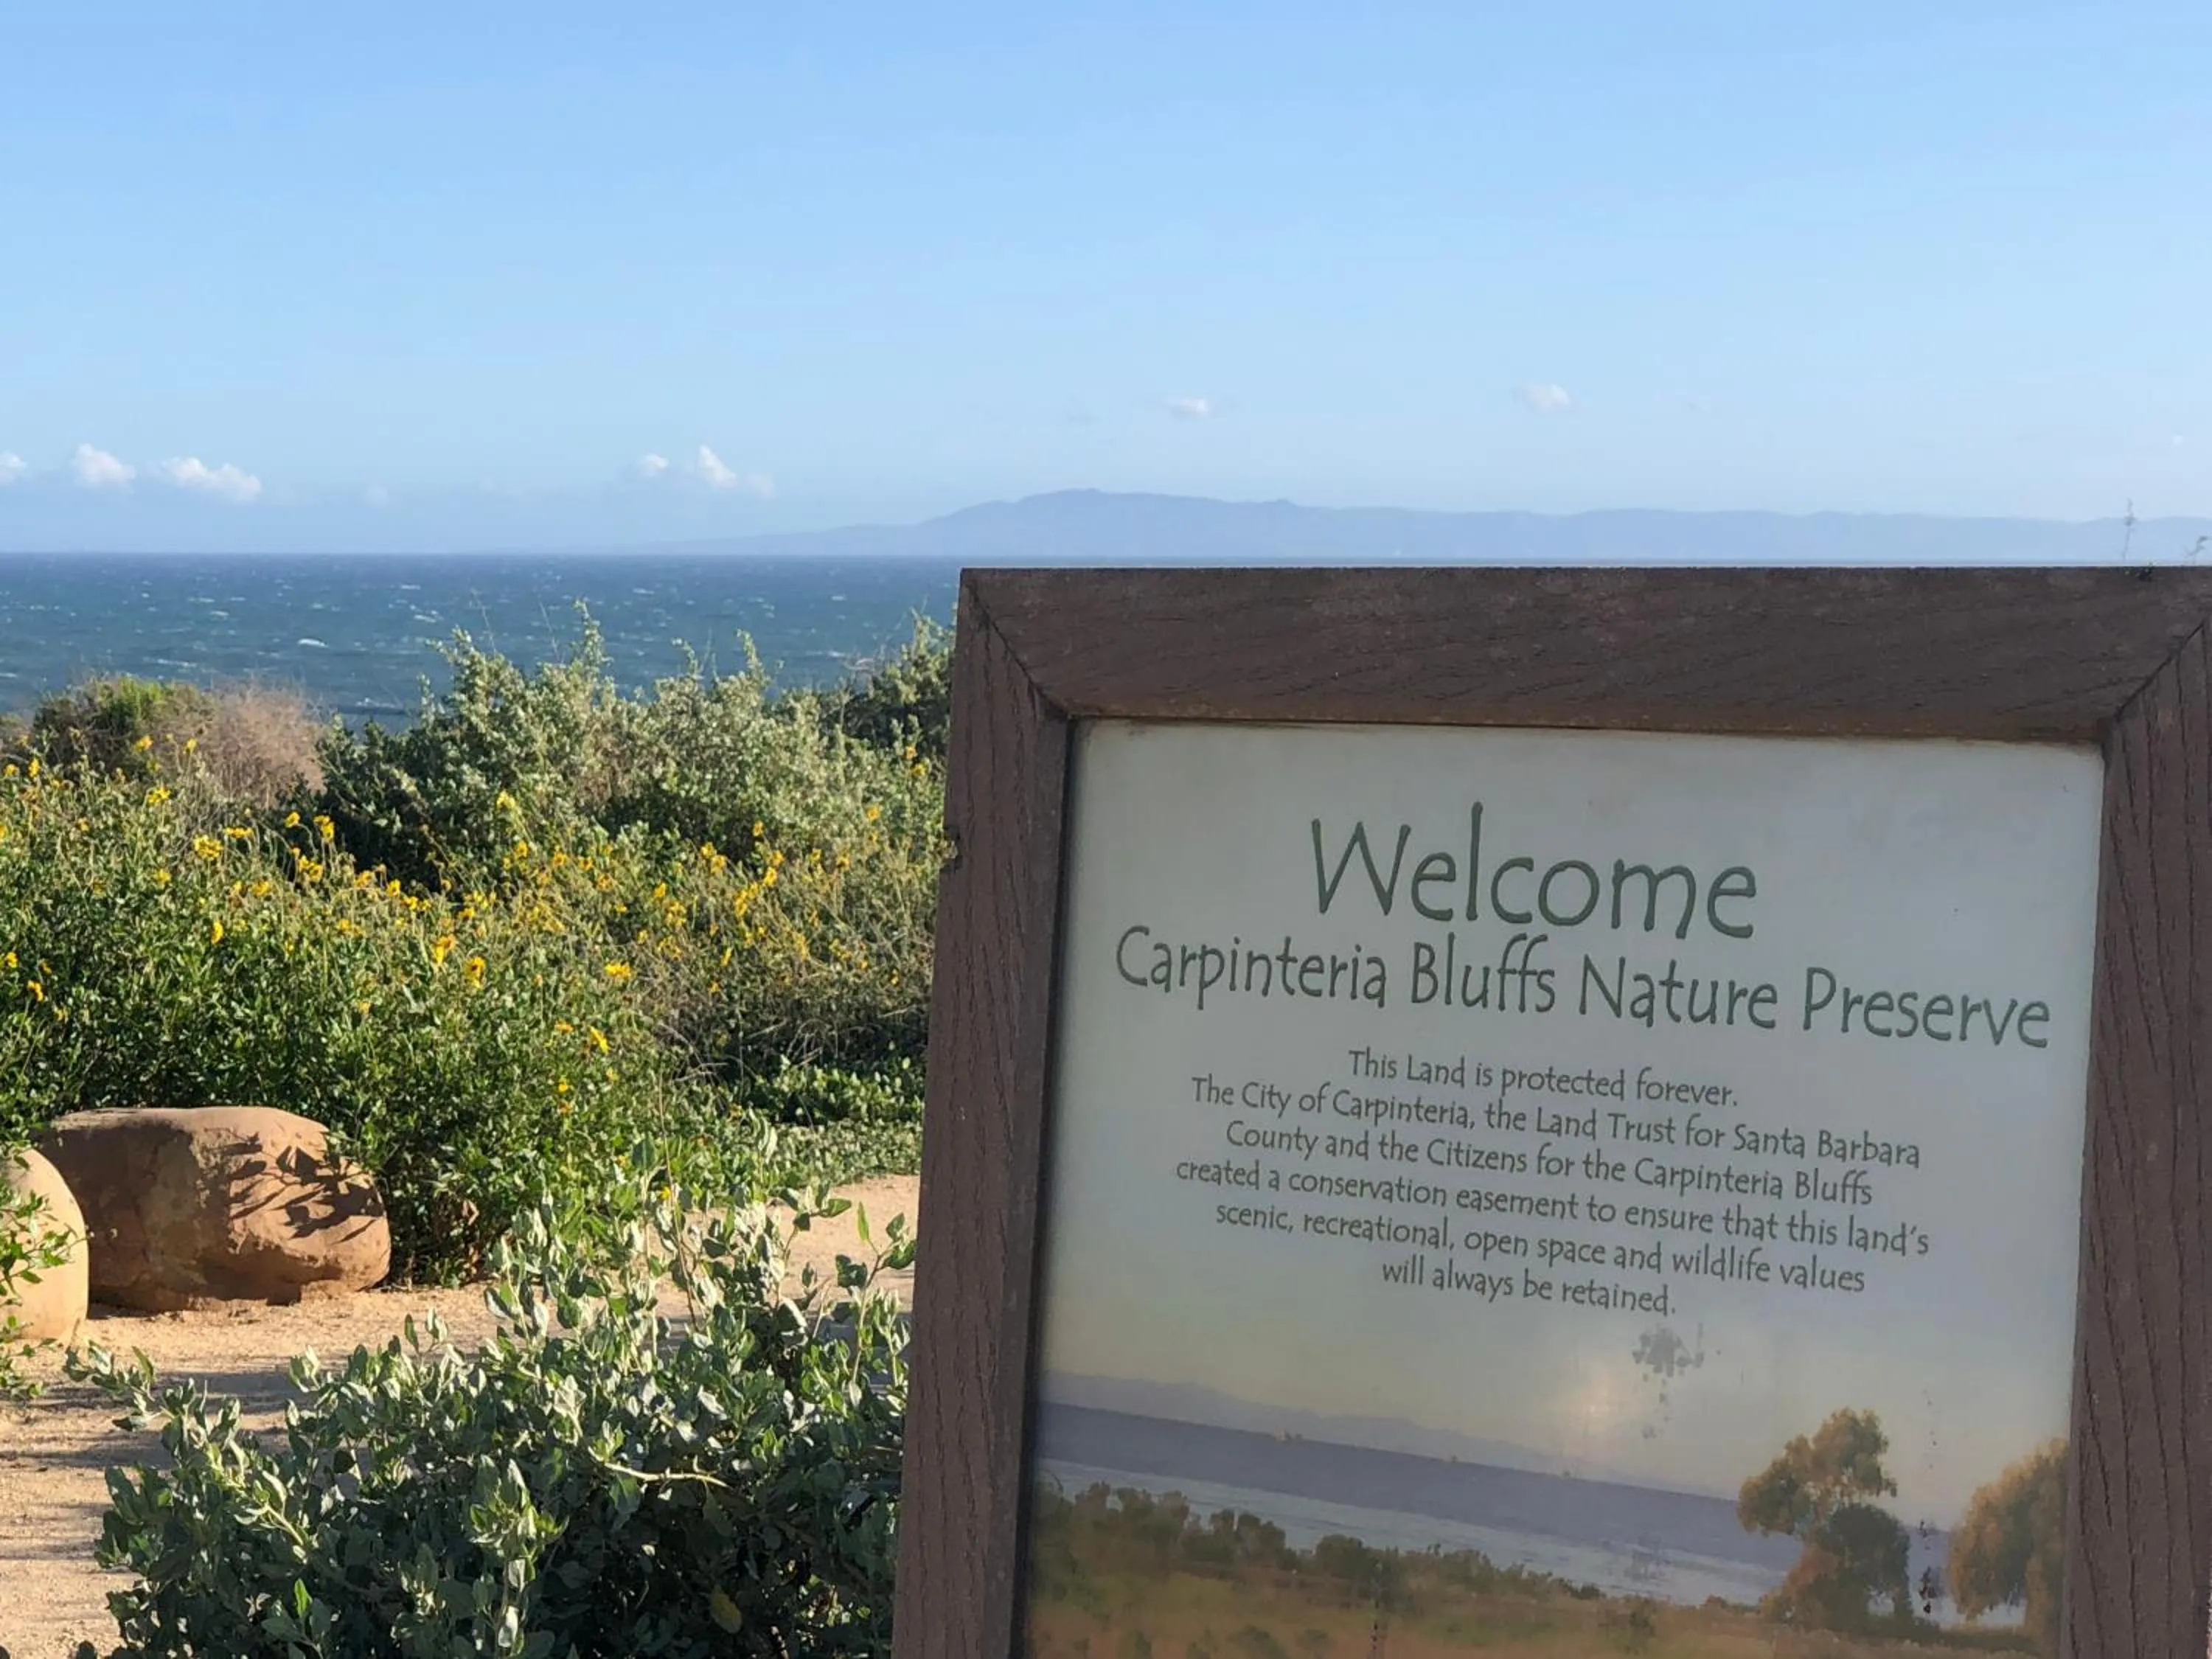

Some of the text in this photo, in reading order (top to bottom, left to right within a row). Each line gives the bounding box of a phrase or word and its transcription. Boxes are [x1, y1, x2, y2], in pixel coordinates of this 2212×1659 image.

[1311, 801, 1756, 940] Welcome
[1116, 925, 2050, 1048] Carpinteria Bluffs Nature Preserve
[1348, 1046, 1737, 1107] This Land is protected forever.
[1192, 1074, 1919, 1169] The City of Carpinteria, the Land Trust for Santa Barbara
[1227, 1121, 1873, 1206] County and the Citizens for the Carpinteria Bluffs
[1177, 1159, 1259, 1191] created
[1268, 1170, 1280, 1192] a
[1288, 1173, 1447, 1208] conservation
[1456, 1189, 1579, 1220] easement
[1586, 1194, 1616, 1222] to
[1625, 1206, 1714, 1234] ensure
[1722, 1203, 1778, 1242] that
[1786, 1209, 1837, 1245] this
[1217, 1205, 1864, 1293] scenic, recreational, open space and wildlife values
[1382, 1253, 1675, 1317] will always be retained.
